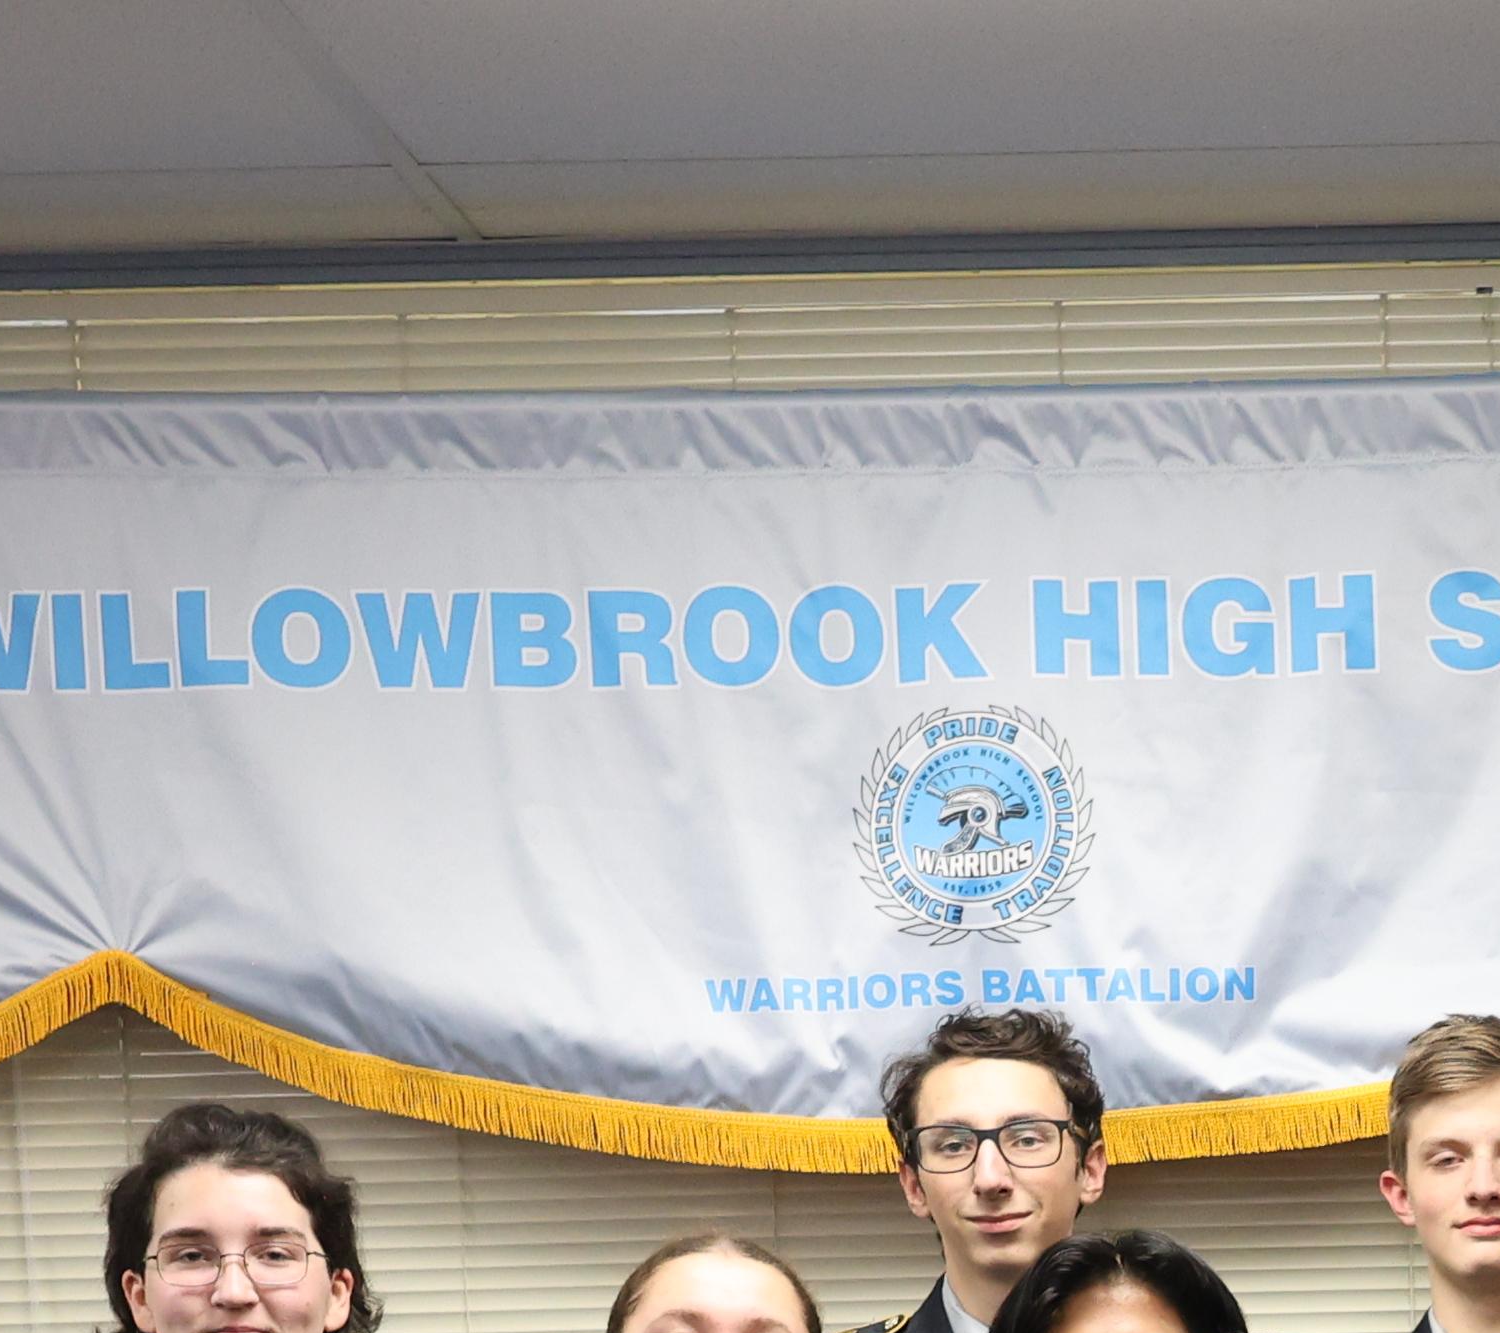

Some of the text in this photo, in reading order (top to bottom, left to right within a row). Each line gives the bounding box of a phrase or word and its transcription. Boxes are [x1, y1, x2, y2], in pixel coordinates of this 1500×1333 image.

[1031, 572, 1379, 680] HIGH
[922, 717, 1019, 748] PRIDE
[903, 748, 1043, 824] WILLOWBROOK HIGH SCHOOL
[875, 762, 964, 924] EXCELLENCE
[913, 840, 1034, 878] WARRIORS
[992, 766, 1074, 920] TRADITION
[974, 881, 1002, 895] 1959
[704, 964, 1258, 1014] WARRIORS BATTALION
